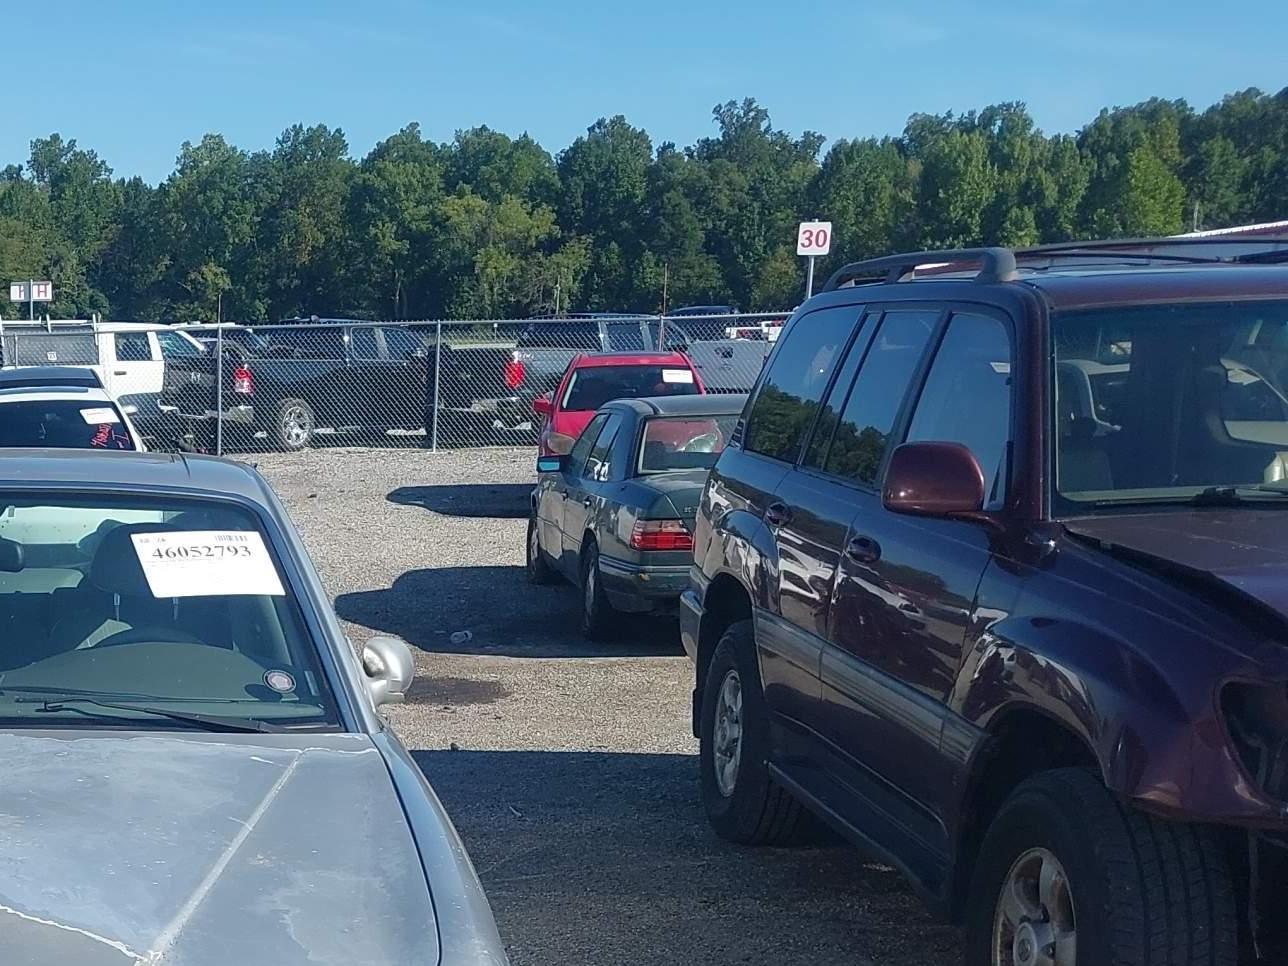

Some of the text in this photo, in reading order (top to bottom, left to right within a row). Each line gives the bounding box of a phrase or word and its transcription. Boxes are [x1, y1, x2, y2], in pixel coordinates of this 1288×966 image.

[800, 229, 828, 248] 30
[37, 284, 48, 298] H
[151, 545, 252, 560] 46052793
